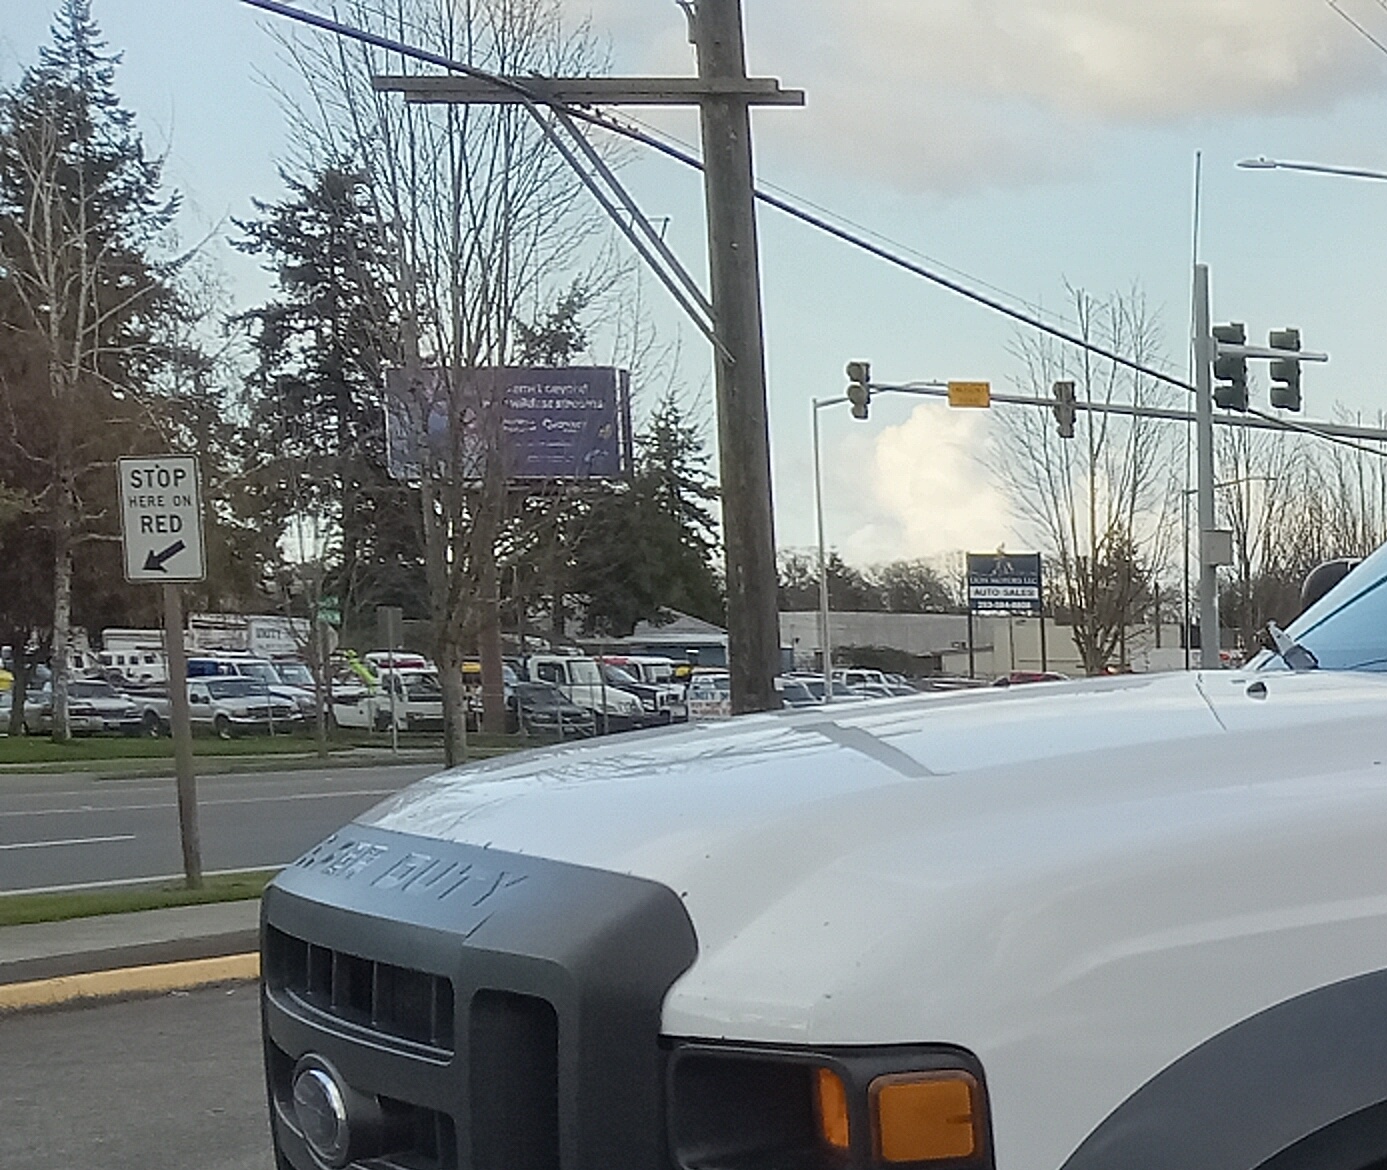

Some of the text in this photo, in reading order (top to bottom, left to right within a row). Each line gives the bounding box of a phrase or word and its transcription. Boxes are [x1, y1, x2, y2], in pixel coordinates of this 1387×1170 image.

[131, 469, 187, 489] STOP
[129, 495, 191, 508] HERE ON
[141, 515, 183, 534] RED
[975, 588, 1000, 596] AUTO
[370, 852, 529, 907] DUTY
